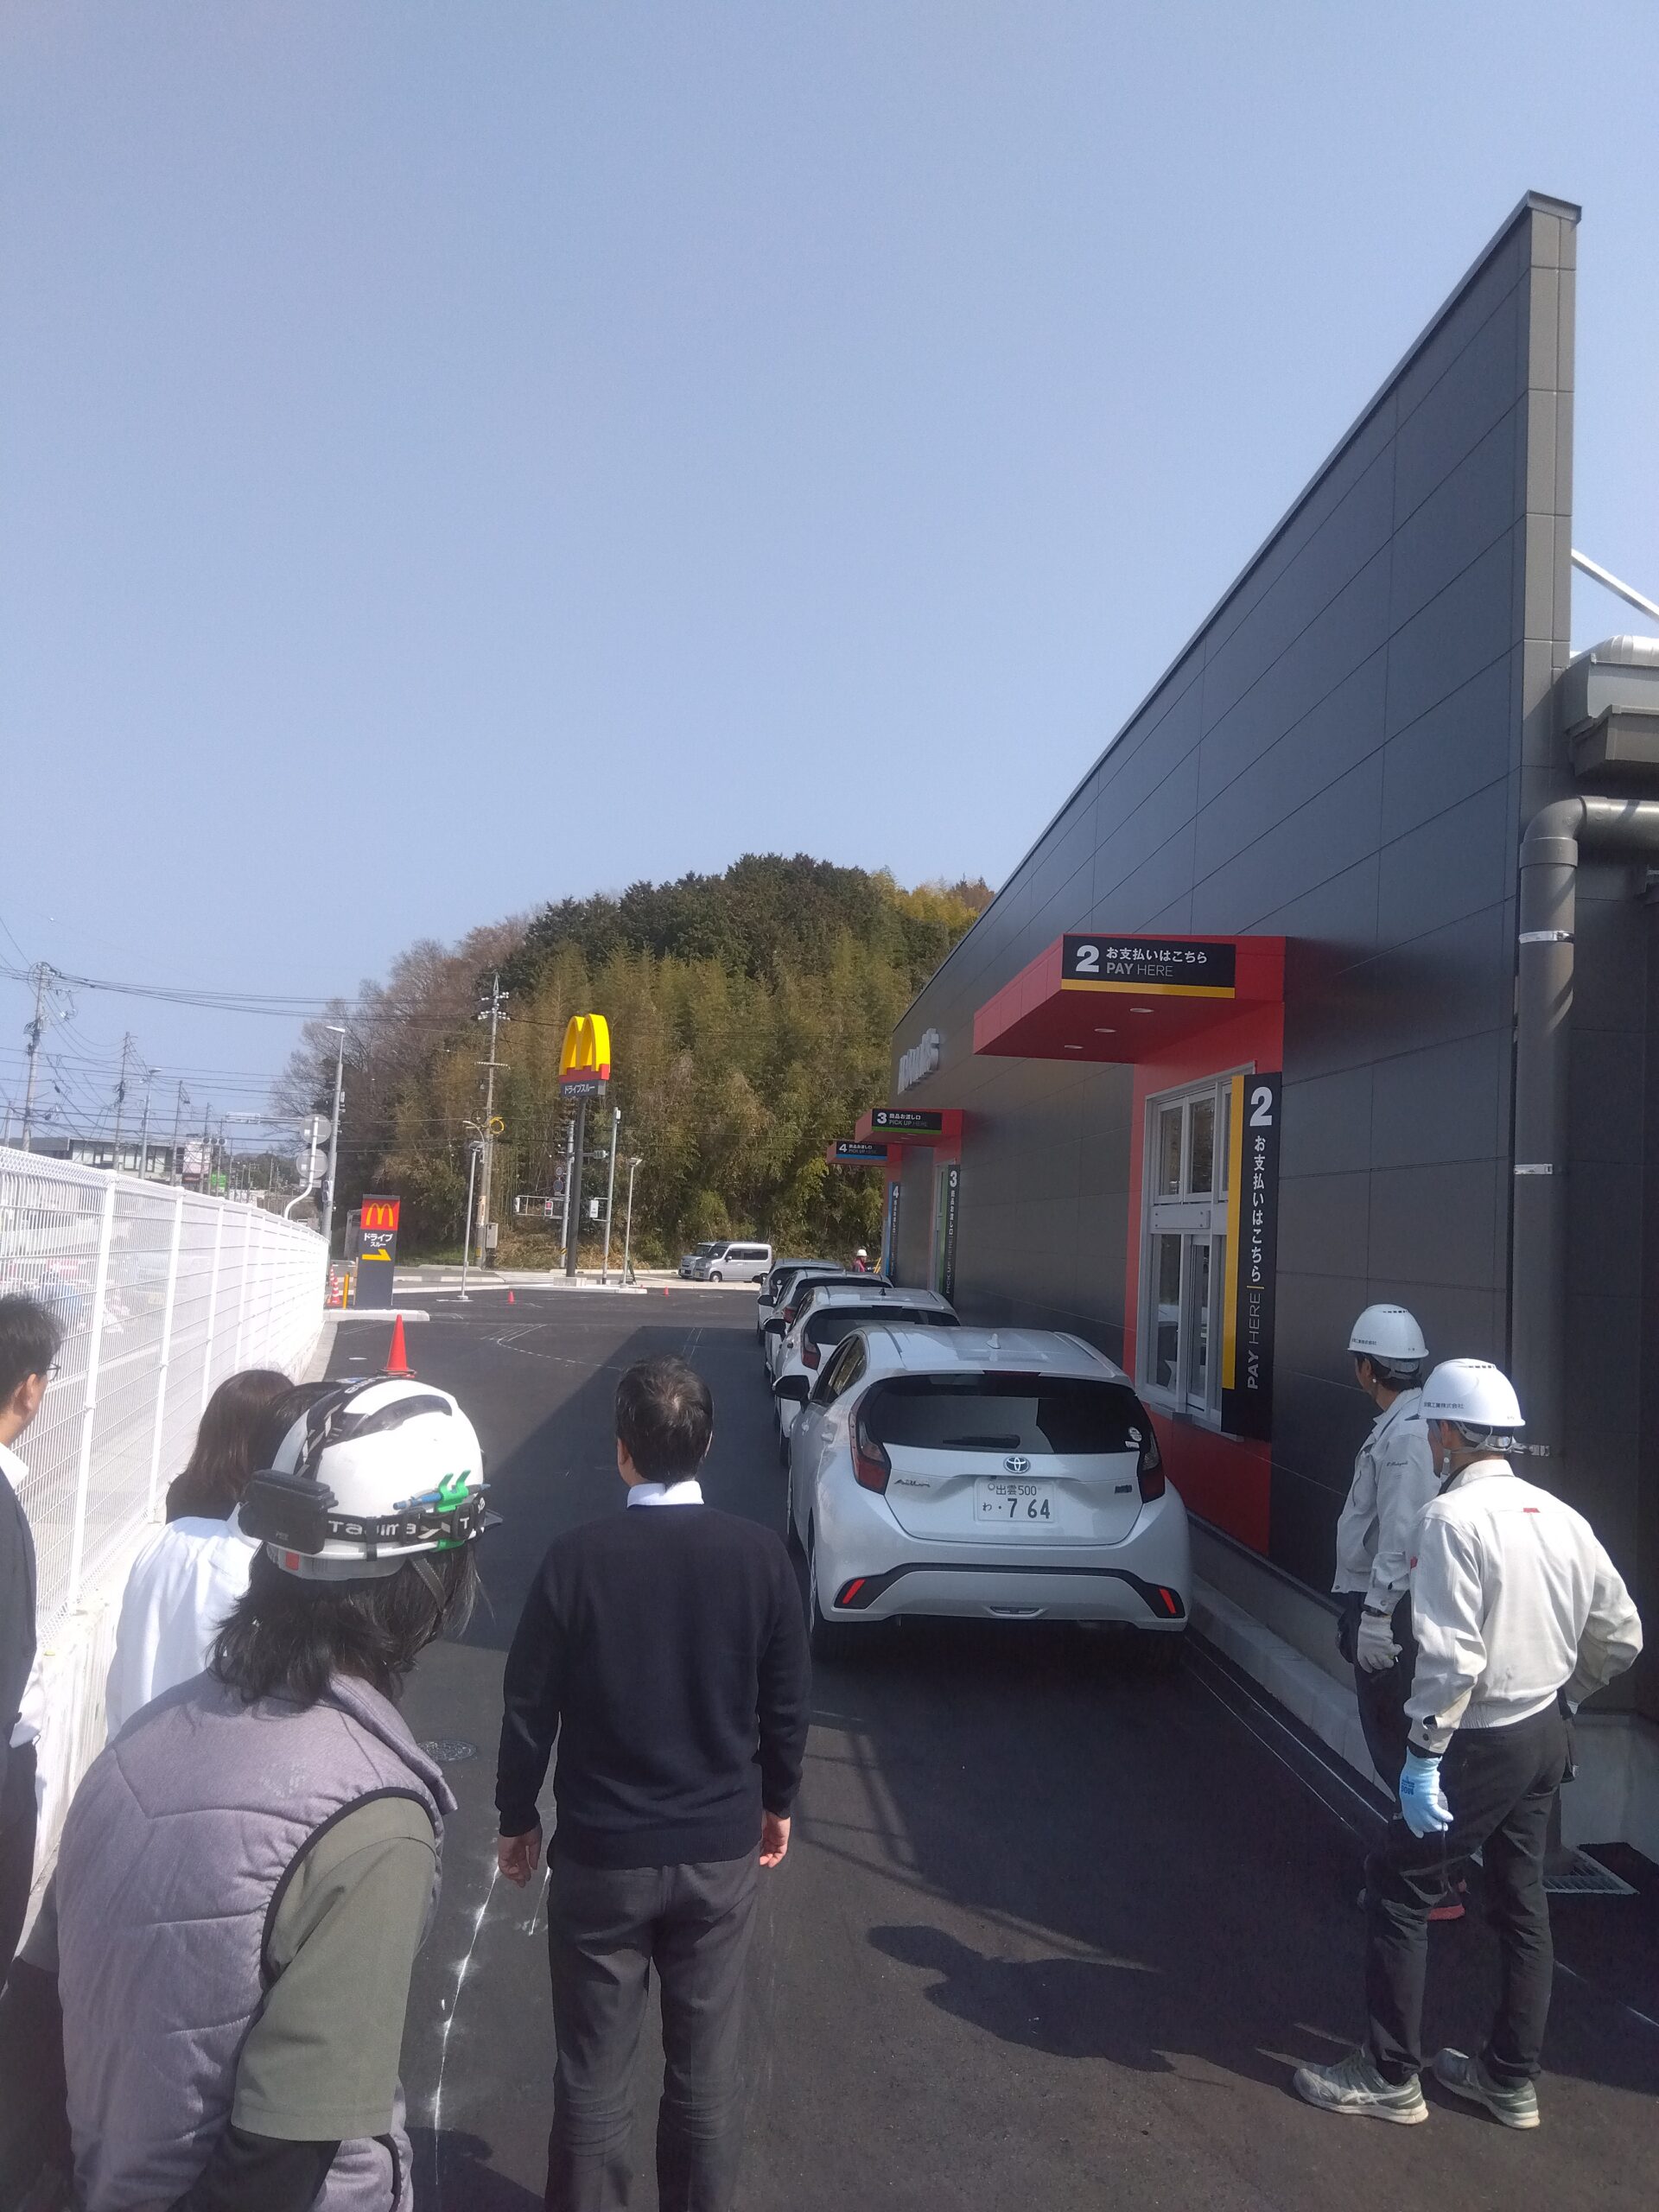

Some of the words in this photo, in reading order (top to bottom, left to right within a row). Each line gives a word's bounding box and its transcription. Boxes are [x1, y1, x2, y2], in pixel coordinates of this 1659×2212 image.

[1076, 944, 1100, 973] 2
[1106, 947, 1208, 964] お支払いはこちら
[1106, 962, 1134, 975] PAY
[1137, 964, 1174, 977] HERE
[564, 1084, 595, 1095] ドライブスルー
[1249, 1086, 1273, 1127] 2
[876, 1112, 887, 1124] 3
[839, 1143, 848, 1153] 4
[950, 1170, 957, 1187] 3
[893, 1185, 899, 1198] 4
[1251, 1135, 1266, 1282] お支払いはこちら
[364, 1232, 394, 1243] ドライブ
[1249, 1293, 1261, 1344] HERE
[1247, 1350, 1259, 1389] PAY
